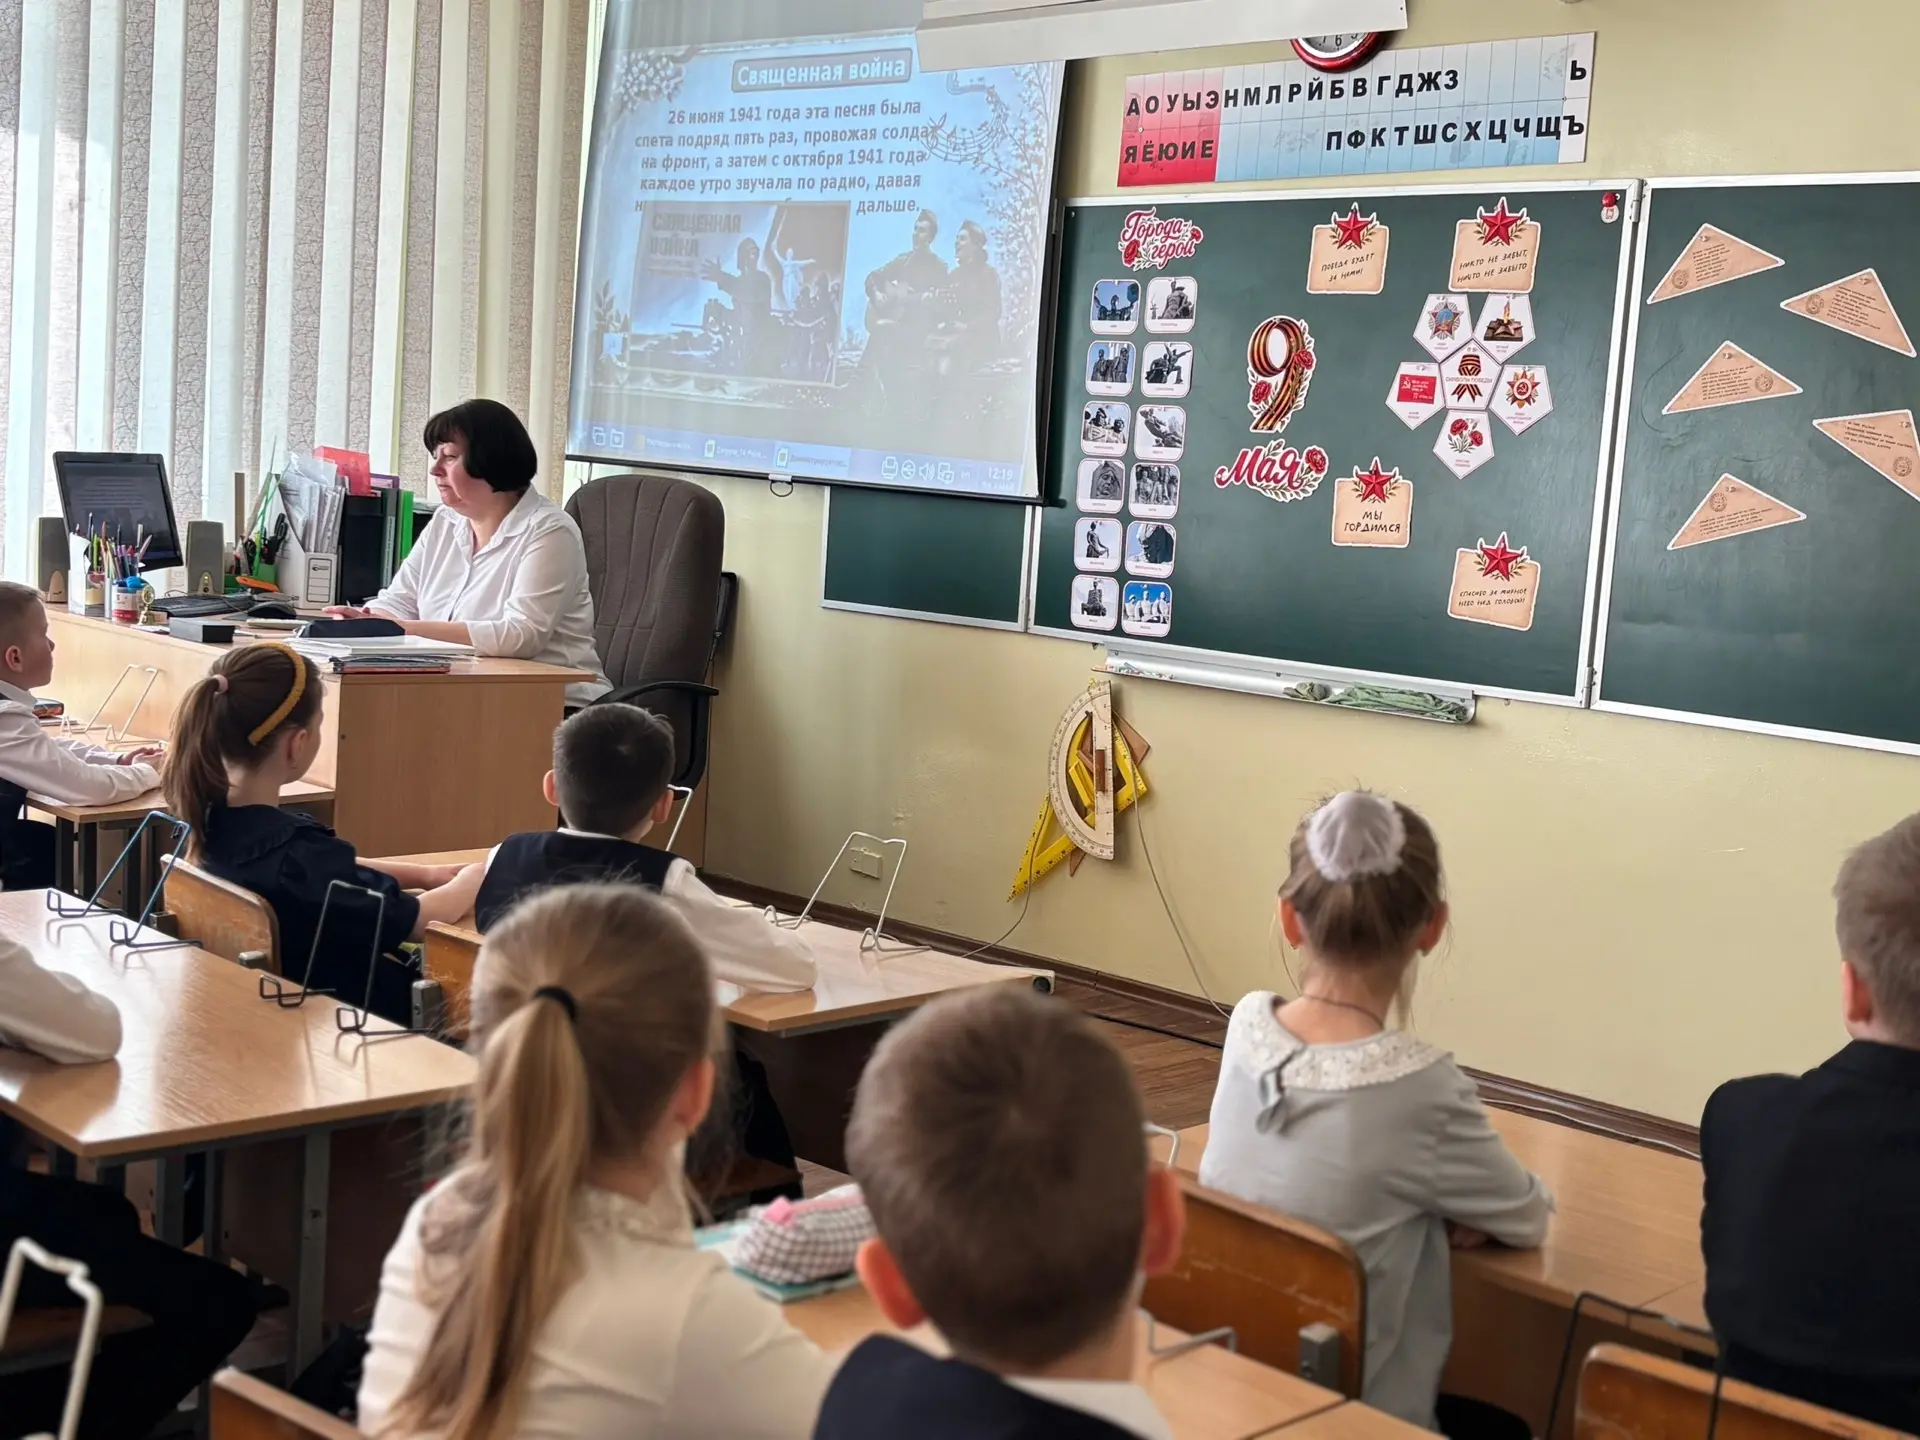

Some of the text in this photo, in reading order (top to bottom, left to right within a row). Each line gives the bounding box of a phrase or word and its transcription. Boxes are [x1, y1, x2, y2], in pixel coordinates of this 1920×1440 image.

[737, 56, 906, 87] Священная война
[668, 98, 921, 125] 26 июня 1941 года эта песня была
[635, 134, 673, 148] спета
[677, 133, 730, 149] подряд
[734, 131, 765, 146] пять
[769, 130, 798, 147] раз,
[804, 127, 877, 146] провожая
[641, 149, 925, 172] на фронт, а затем с октября 1941 года
[640, 174, 921, 194] каждое утро звучала по радио, давая
[856, 199, 920, 215] дальше.
[1150, 240, 1195, 268] герои
[1487, 255, 1498, 264] НЕ
[1250, 316, 1306, 431] 9
[988, 466, 1014, 481] 12:19
[1362, 510, 1383, 521] МЫ
[1344, 522, 1401, 534] ГОРДИМСЯ
